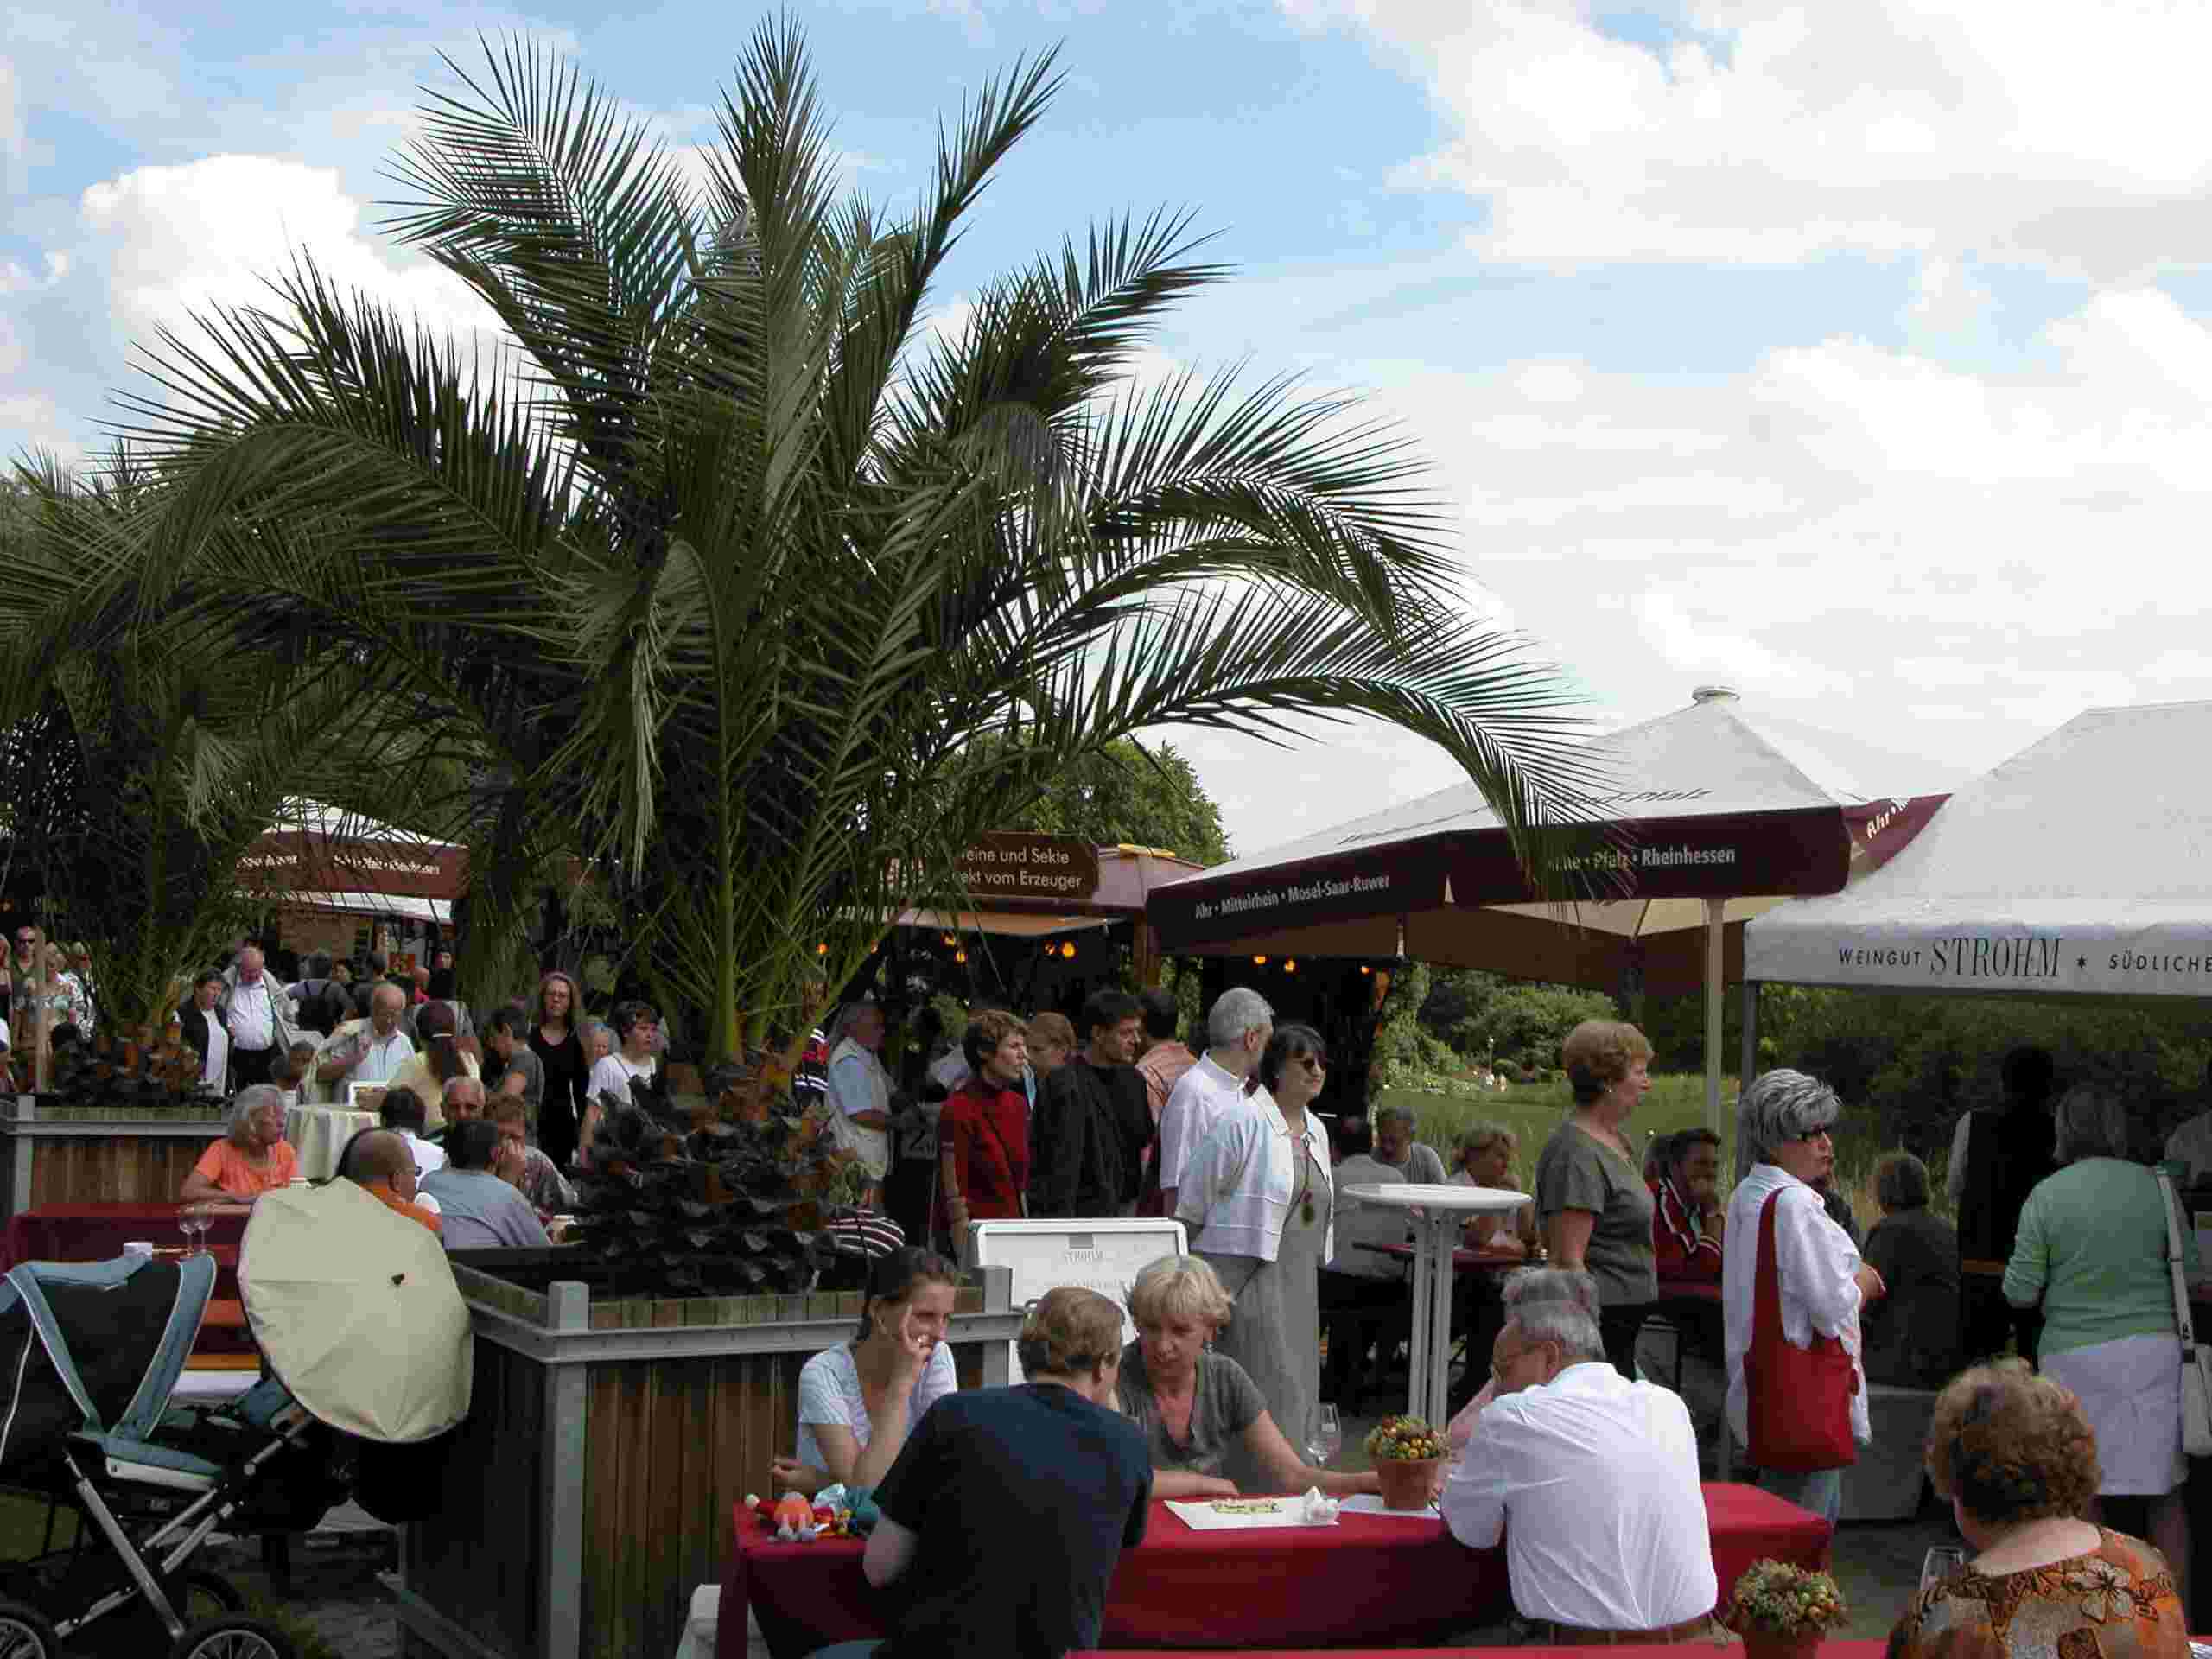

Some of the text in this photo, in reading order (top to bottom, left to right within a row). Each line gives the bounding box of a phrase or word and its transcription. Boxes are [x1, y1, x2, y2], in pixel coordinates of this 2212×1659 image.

[1866, 811, 1891, 839] Ahr
[1000, 845, 1027, 863] und
[1031, 847, 1070, 865] Sekte
[1642, 846, 1736, 866] Rheinhessen
[985, 871, 1015, 886] vom
[1020, 870, 1082, 892] Erzeuger
[1195, 874, 1390, 919] Ahr Mittelrhein Mosel-Saar-Ruwer
[1839, 948, 1922, 967] WEINGUT
[1929, 937, 2063, 977] STROHM
